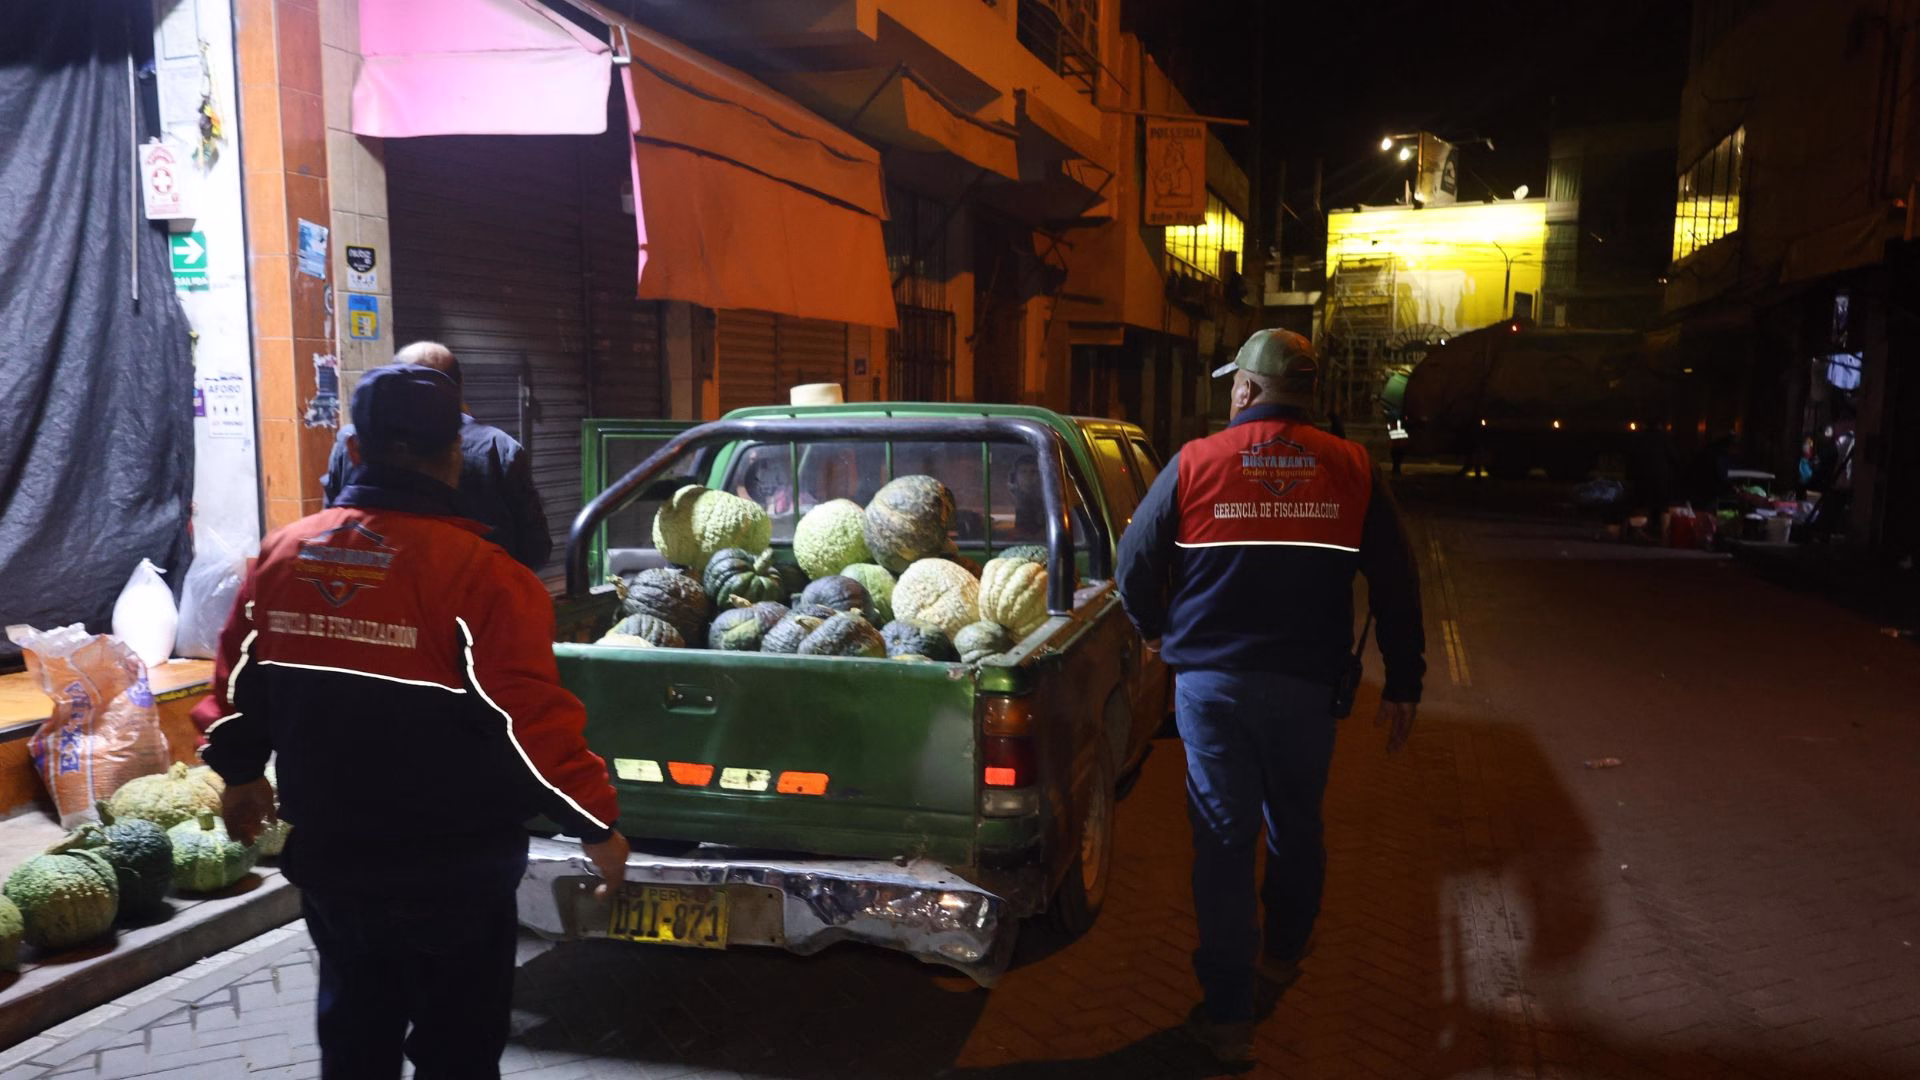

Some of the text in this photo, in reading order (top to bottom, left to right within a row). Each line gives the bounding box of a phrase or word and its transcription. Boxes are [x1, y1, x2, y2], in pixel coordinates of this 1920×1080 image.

[1214, 500, 1340, 519] GERENCIA DE FISCALIZACIÓN
